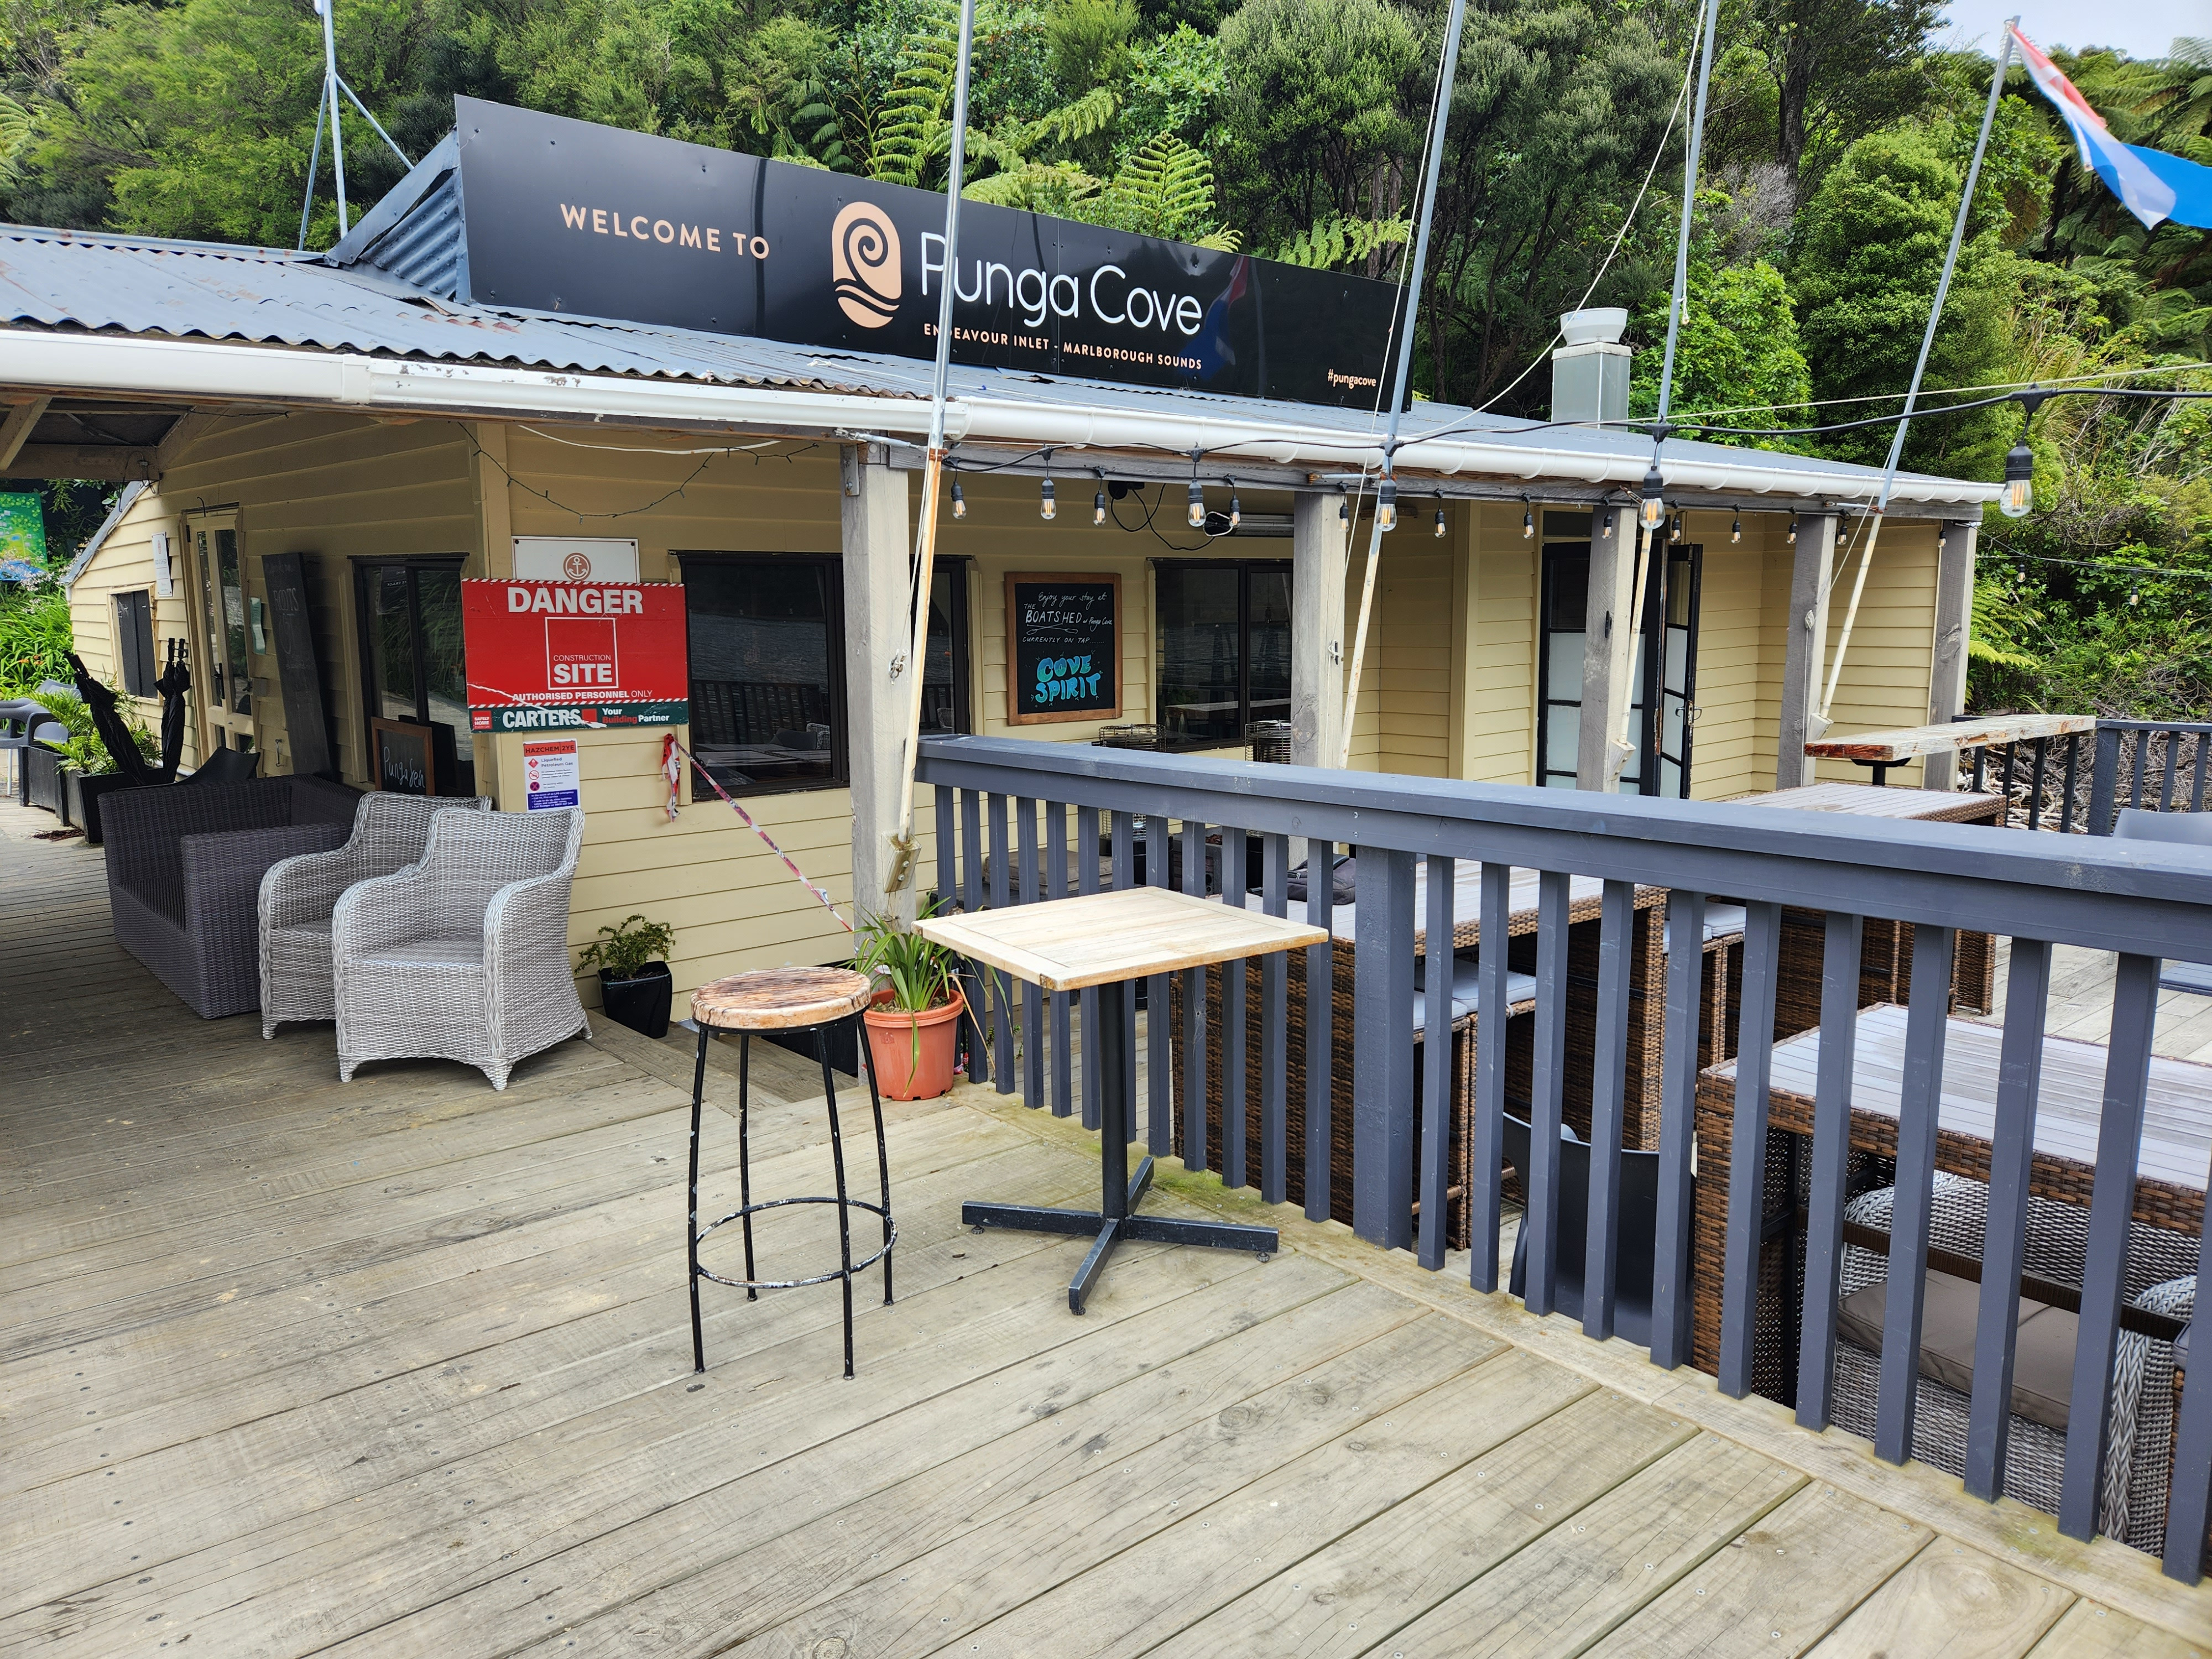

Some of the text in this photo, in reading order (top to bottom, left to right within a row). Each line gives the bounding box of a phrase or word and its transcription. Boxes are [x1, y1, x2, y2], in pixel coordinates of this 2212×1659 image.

[560, 204, 769, 259] WELCOME TO
[921, 232, 1202, 335] Punga Cove
[924, 324, 1008, 345] ENEAVOUR
[1014, 335, 1049, 349] INLET
[1063, 341, 1154, 364] MARLBOROUGH
[1157, 354, 1202, 370] SOUNDS
[1328, 368, 1376, 389] #pungacove
[508, 587, 644, 614] DANGER
[1038, 591, 1107, 610] Enjoy your stay at
[1025, 610, 1082, 623] BOATSHED
[554, 664, 613, 684] SITE
[1037, 654, 1092, 682] COVE
[512, 692, 573, 702] AUTHORISED
[575, 691, 629, 700] PERSONNEL
[1035, 672, 1100, 703] SPIRIT
[503, 708, 581, 728] CARTERS
[602, 714, 670, 724] Building Partner
[383, 746, 409, 785] Punga
